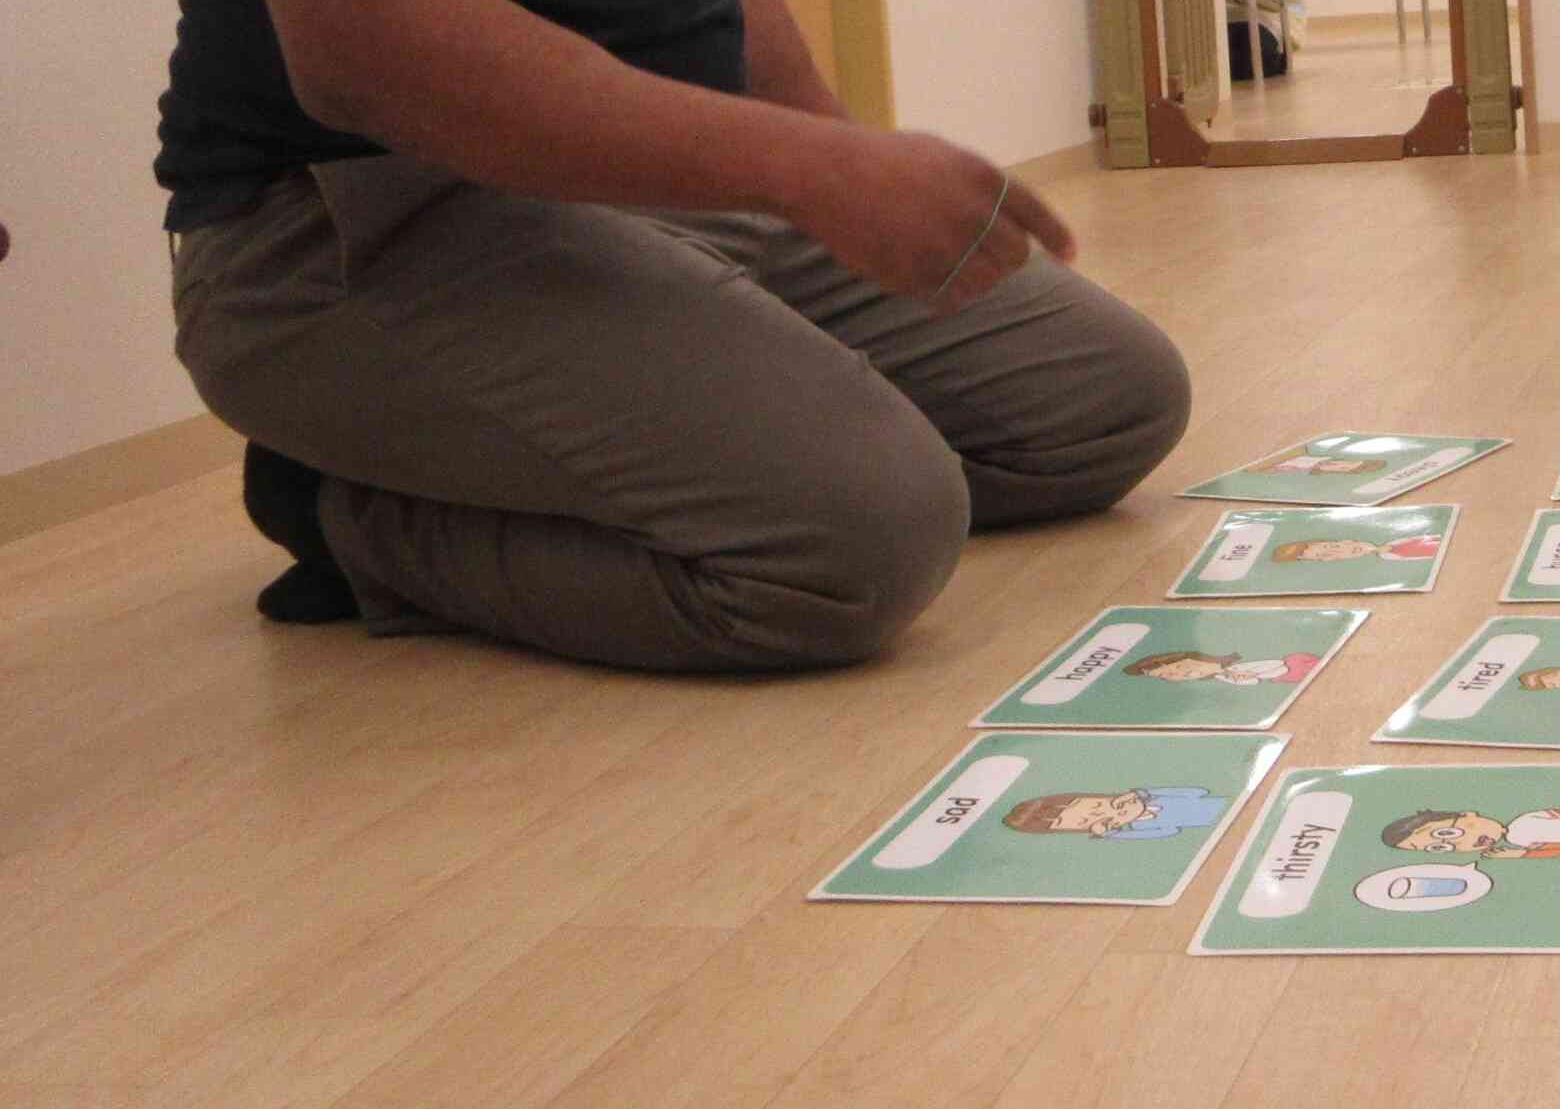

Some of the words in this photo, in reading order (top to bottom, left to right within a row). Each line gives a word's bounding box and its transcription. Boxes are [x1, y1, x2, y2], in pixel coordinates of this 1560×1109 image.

[1220, 544, 1253, 561] fine
[1055, 646, 1123, 681] happy
[1457, 661, 1505, 690] tired
[936, 796, 981, 824] sad
[1271, 823, 1337, 881] thirsty
